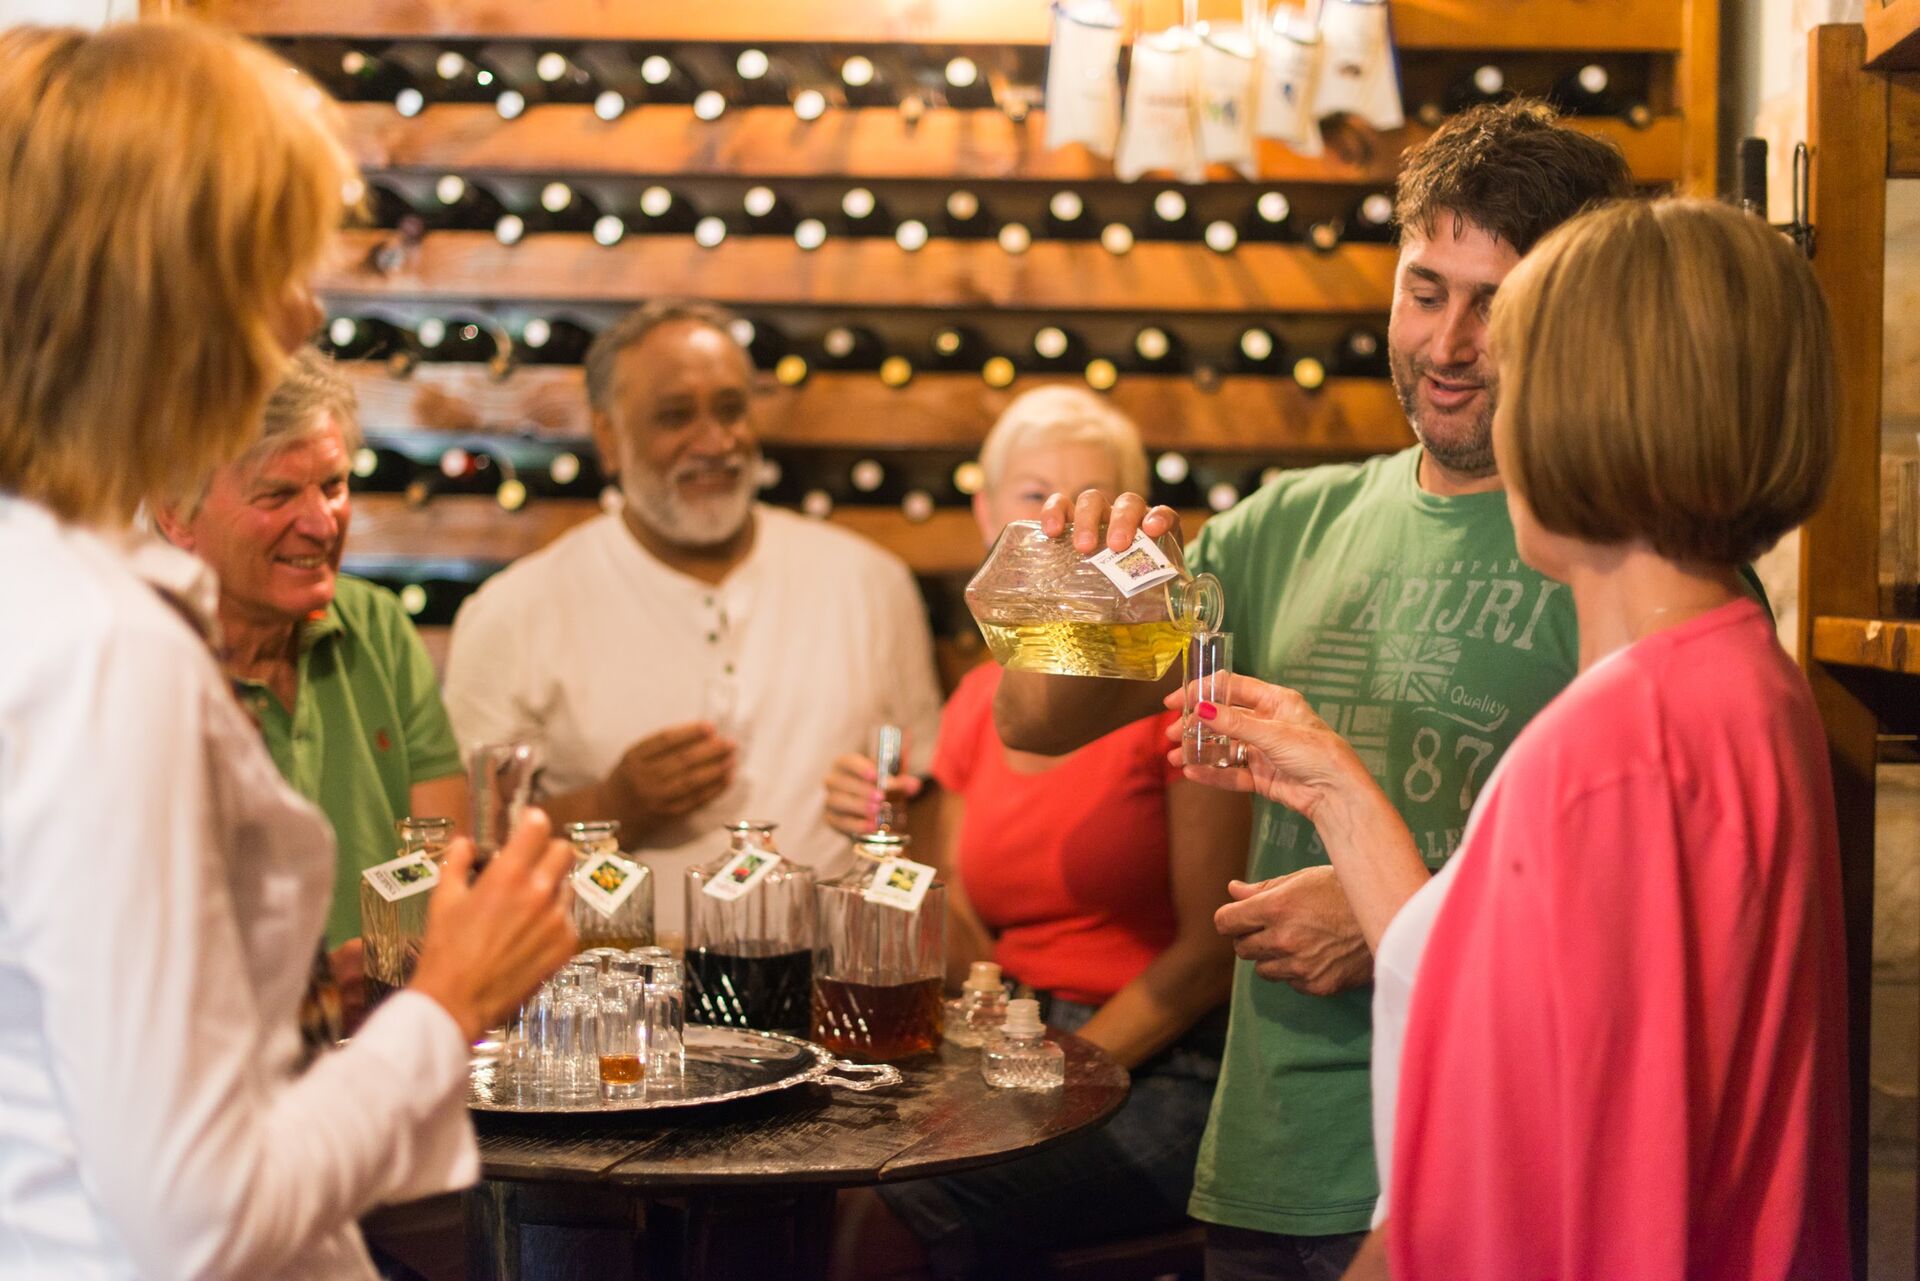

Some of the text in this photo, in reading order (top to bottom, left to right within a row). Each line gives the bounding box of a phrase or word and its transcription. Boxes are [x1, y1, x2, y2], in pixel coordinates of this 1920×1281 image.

[1422, 559, 1534, 575] COMPAN
[1450, 684, 1506, 718] Quality
[1403, 727, 1494, 811] 87
